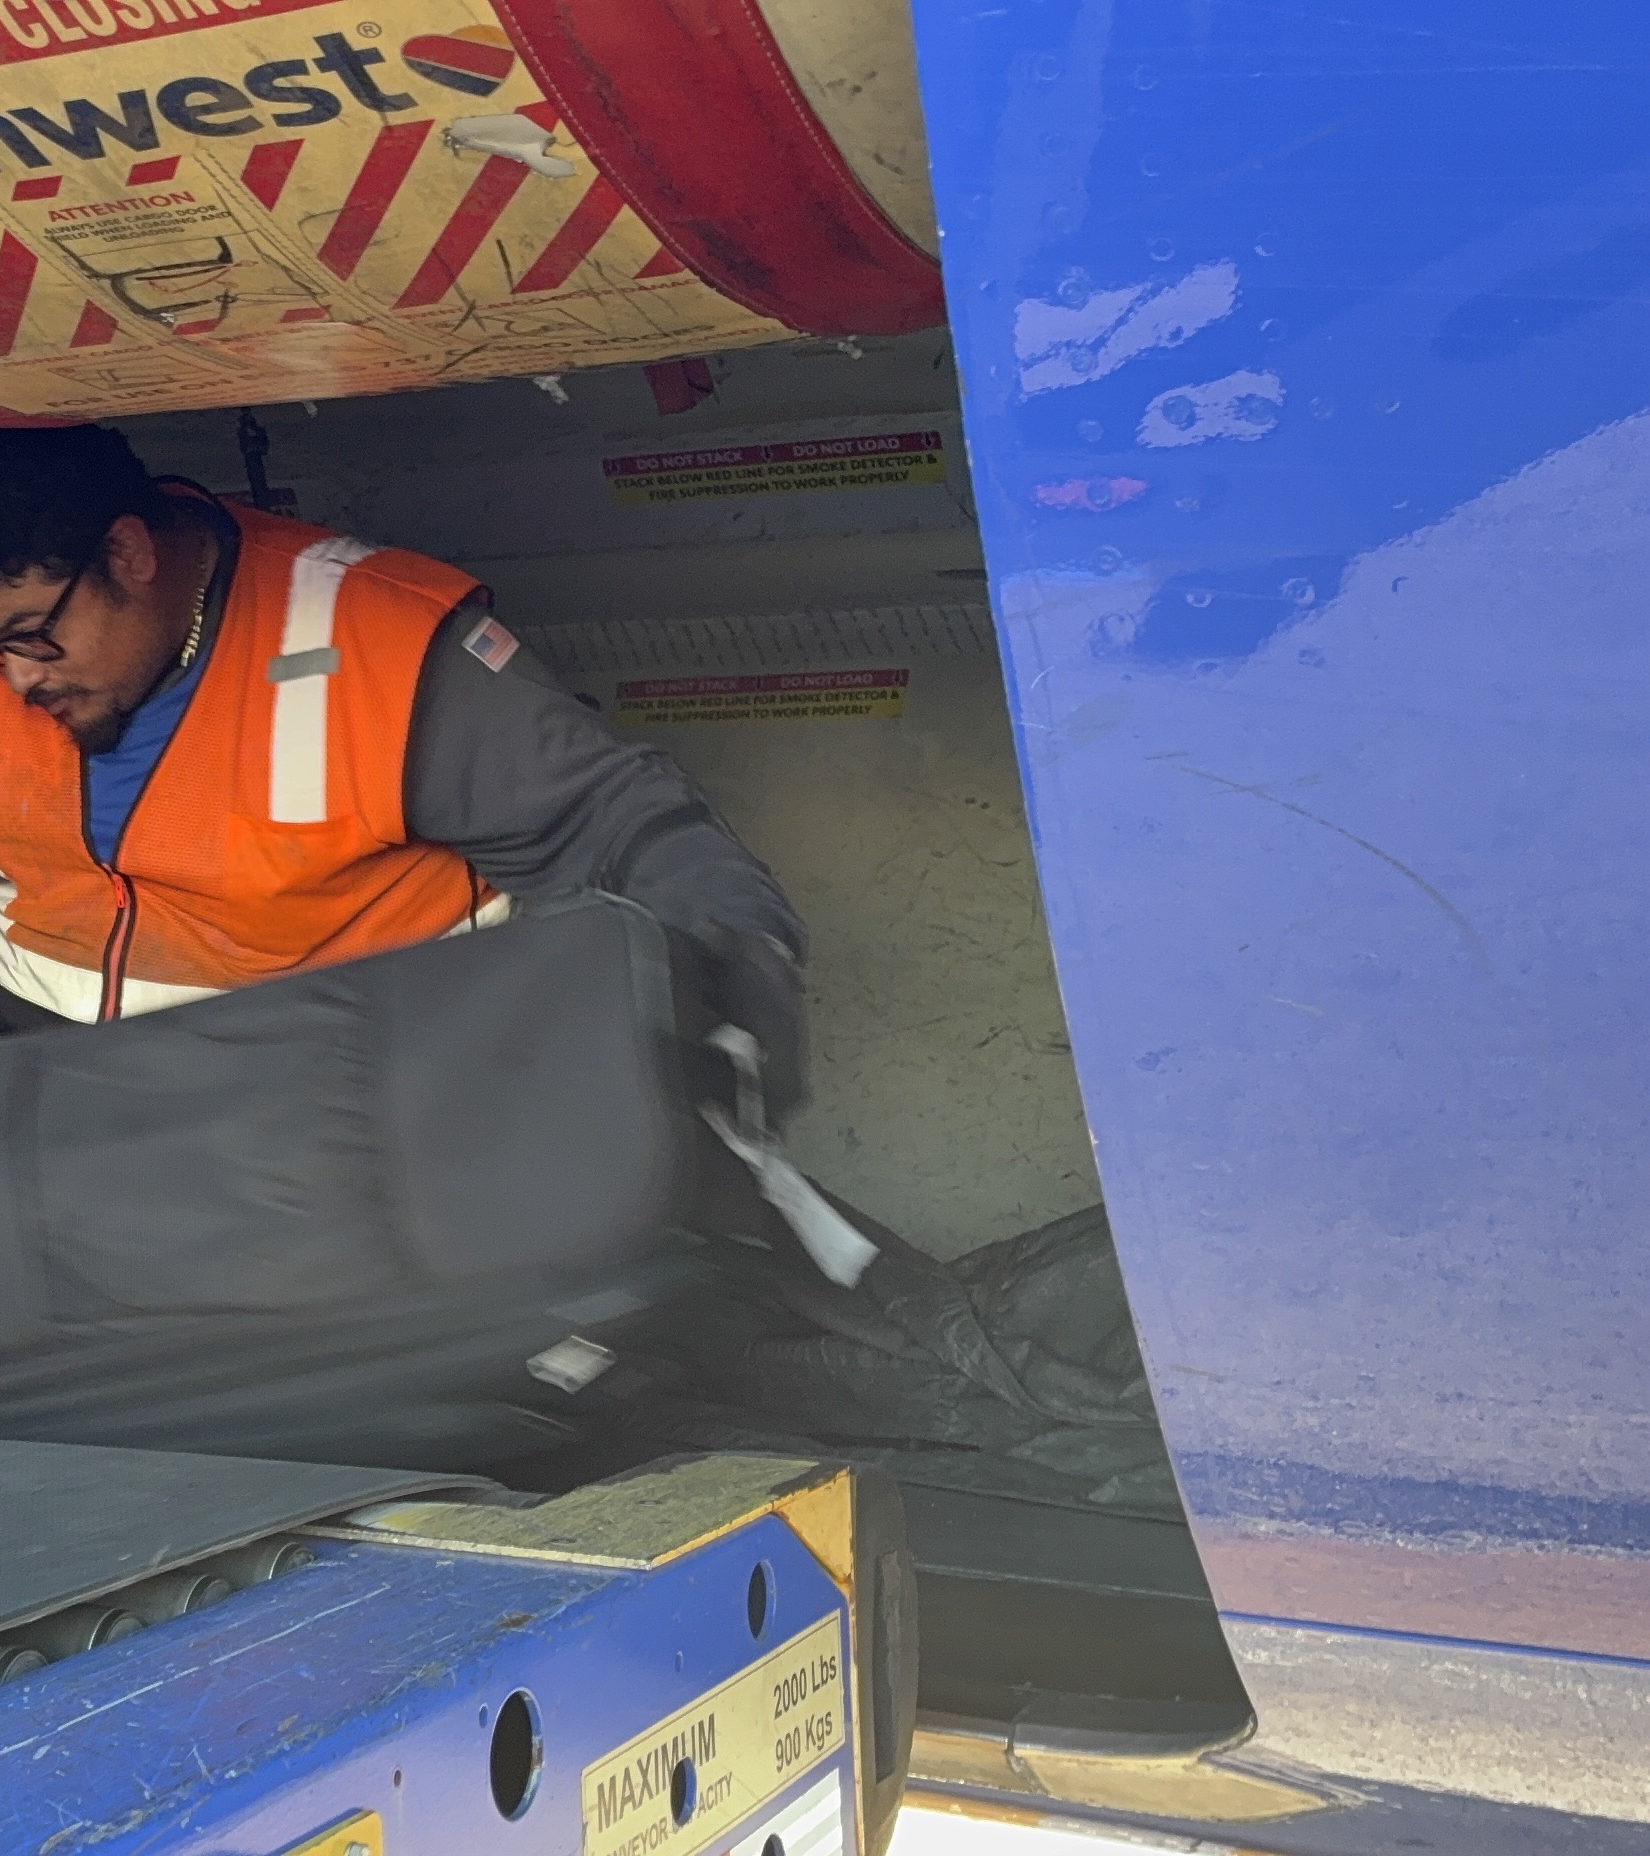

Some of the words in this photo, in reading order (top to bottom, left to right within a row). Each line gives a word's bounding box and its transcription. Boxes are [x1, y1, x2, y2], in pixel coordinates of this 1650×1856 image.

[43, 222, 95, 235] ALWAYS
[96, 218, 122, 227] USE
[123, 211, 173, 223] CARGO
[175, 204, 218, 217] DOOR
[47, 190, 197, 223] ATTENTION
[91, 224, 133, 237] WHEN
[135, 216, 198, 230] LOADING
[200, 211, 232, 222] AND
[102, 226, 186, 243] UNLOADING
[636, 458, 659, 470] DO
[662, 454, 692, 468] NOT
[695, 450, 743, 466] STACK
[792, 444, 817, 458] DO
[821, 440, 852, 455] NOT
[857, 437, 900, 452] LOAD
[656, 472, 703, 486] BELOW
[705, 469, 732, 481] RED
[735, 466, 765, 479] LINE
[768, 464, 794, 476] FOR
[797, 460, 846, 474] SMOKE
[850, 453, 923, 470] DETECTOR
[679, 480, 770, 498] SUPPRESSION
[771, 480, 792, 491] TO
[795, 475, 837, 490] WORK
[839, 469, 910, 486] PROPERLY
[773, 1667, 808, 1721] 2000
[811, 1655, 838, 1694] Lbs
[775, 1726, 801, 1773] 900
[805, 1711, 833, 1751] Kgs
[597, 1712, 717, 1834] MAXIMUM
